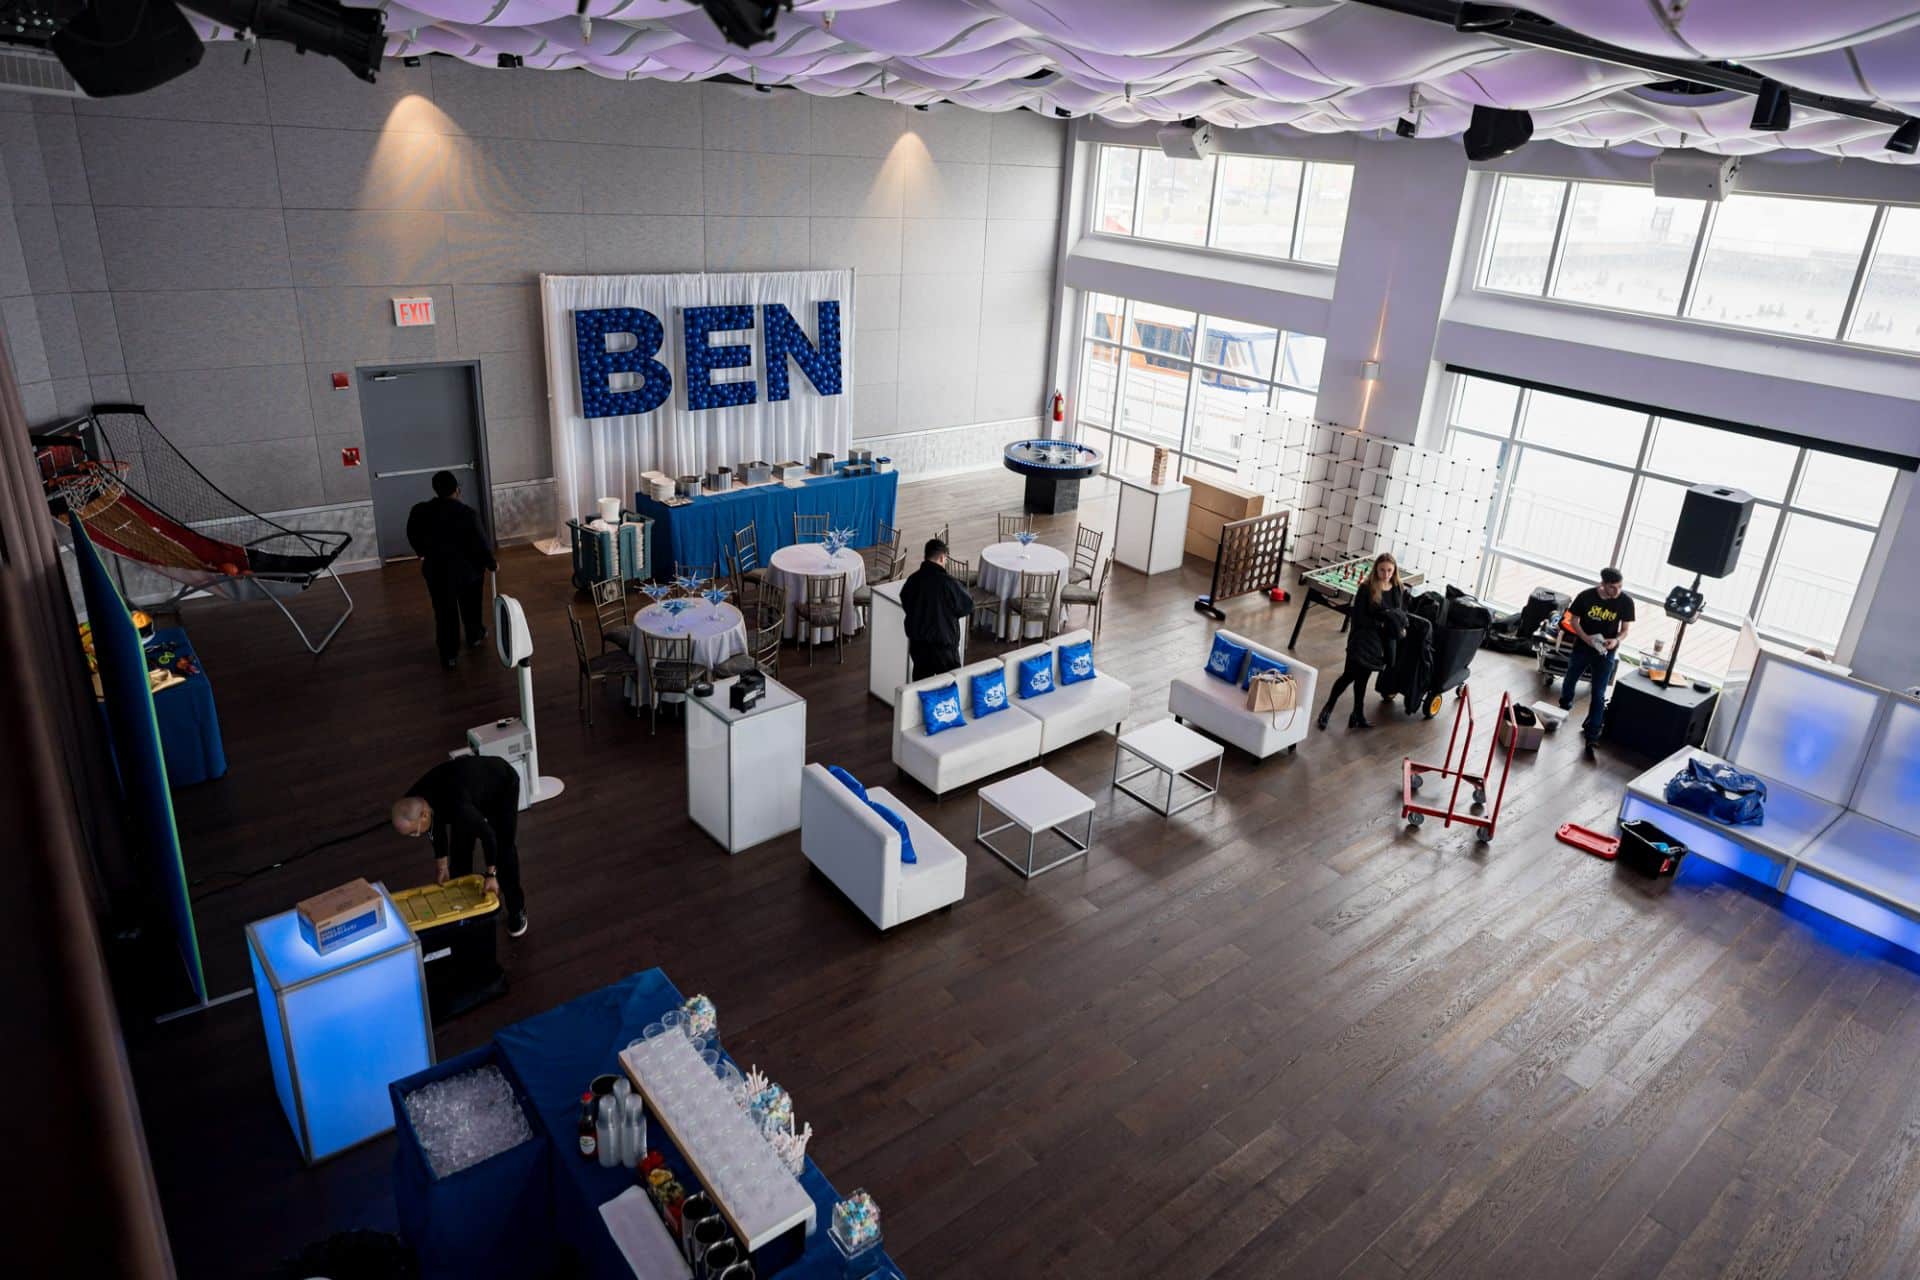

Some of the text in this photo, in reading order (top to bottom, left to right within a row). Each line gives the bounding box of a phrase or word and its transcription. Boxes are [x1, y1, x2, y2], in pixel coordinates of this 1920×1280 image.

[400, 303, 431, 324] EXIT
[574, 300, 843, 419] BEN
[1073, 658, 1092, 670] BEN
[1033, 673, 1050, 686] BEN
[986, 687, 1006, 702] BEN
[935, 701, 958, 717] BEN
